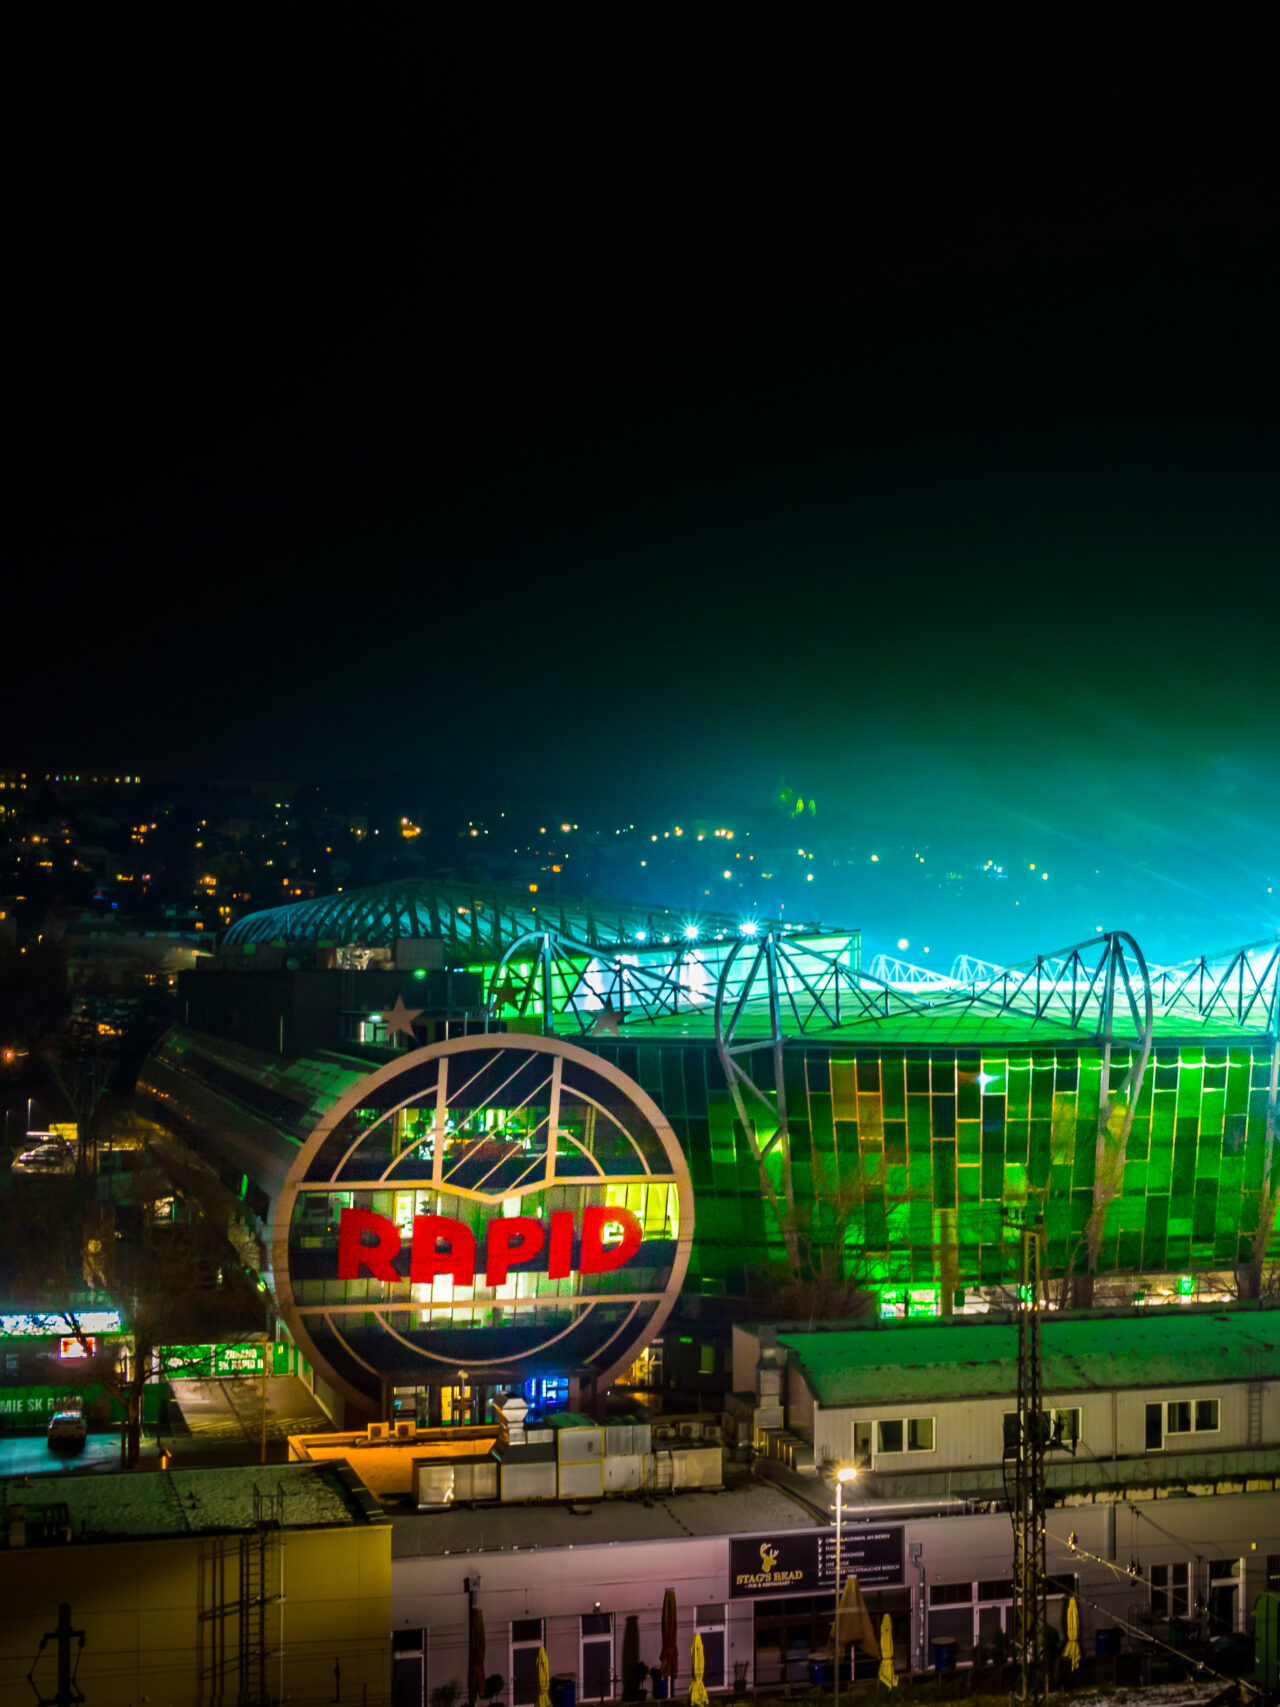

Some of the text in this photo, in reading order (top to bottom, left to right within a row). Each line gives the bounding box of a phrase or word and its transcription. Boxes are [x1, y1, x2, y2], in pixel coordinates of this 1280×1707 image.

[337, 1206, 643, 1287] RAPID
[27, 1398, 42, 1411] SK
[736, 1570, 804, 1585] STAG'S HEAD
